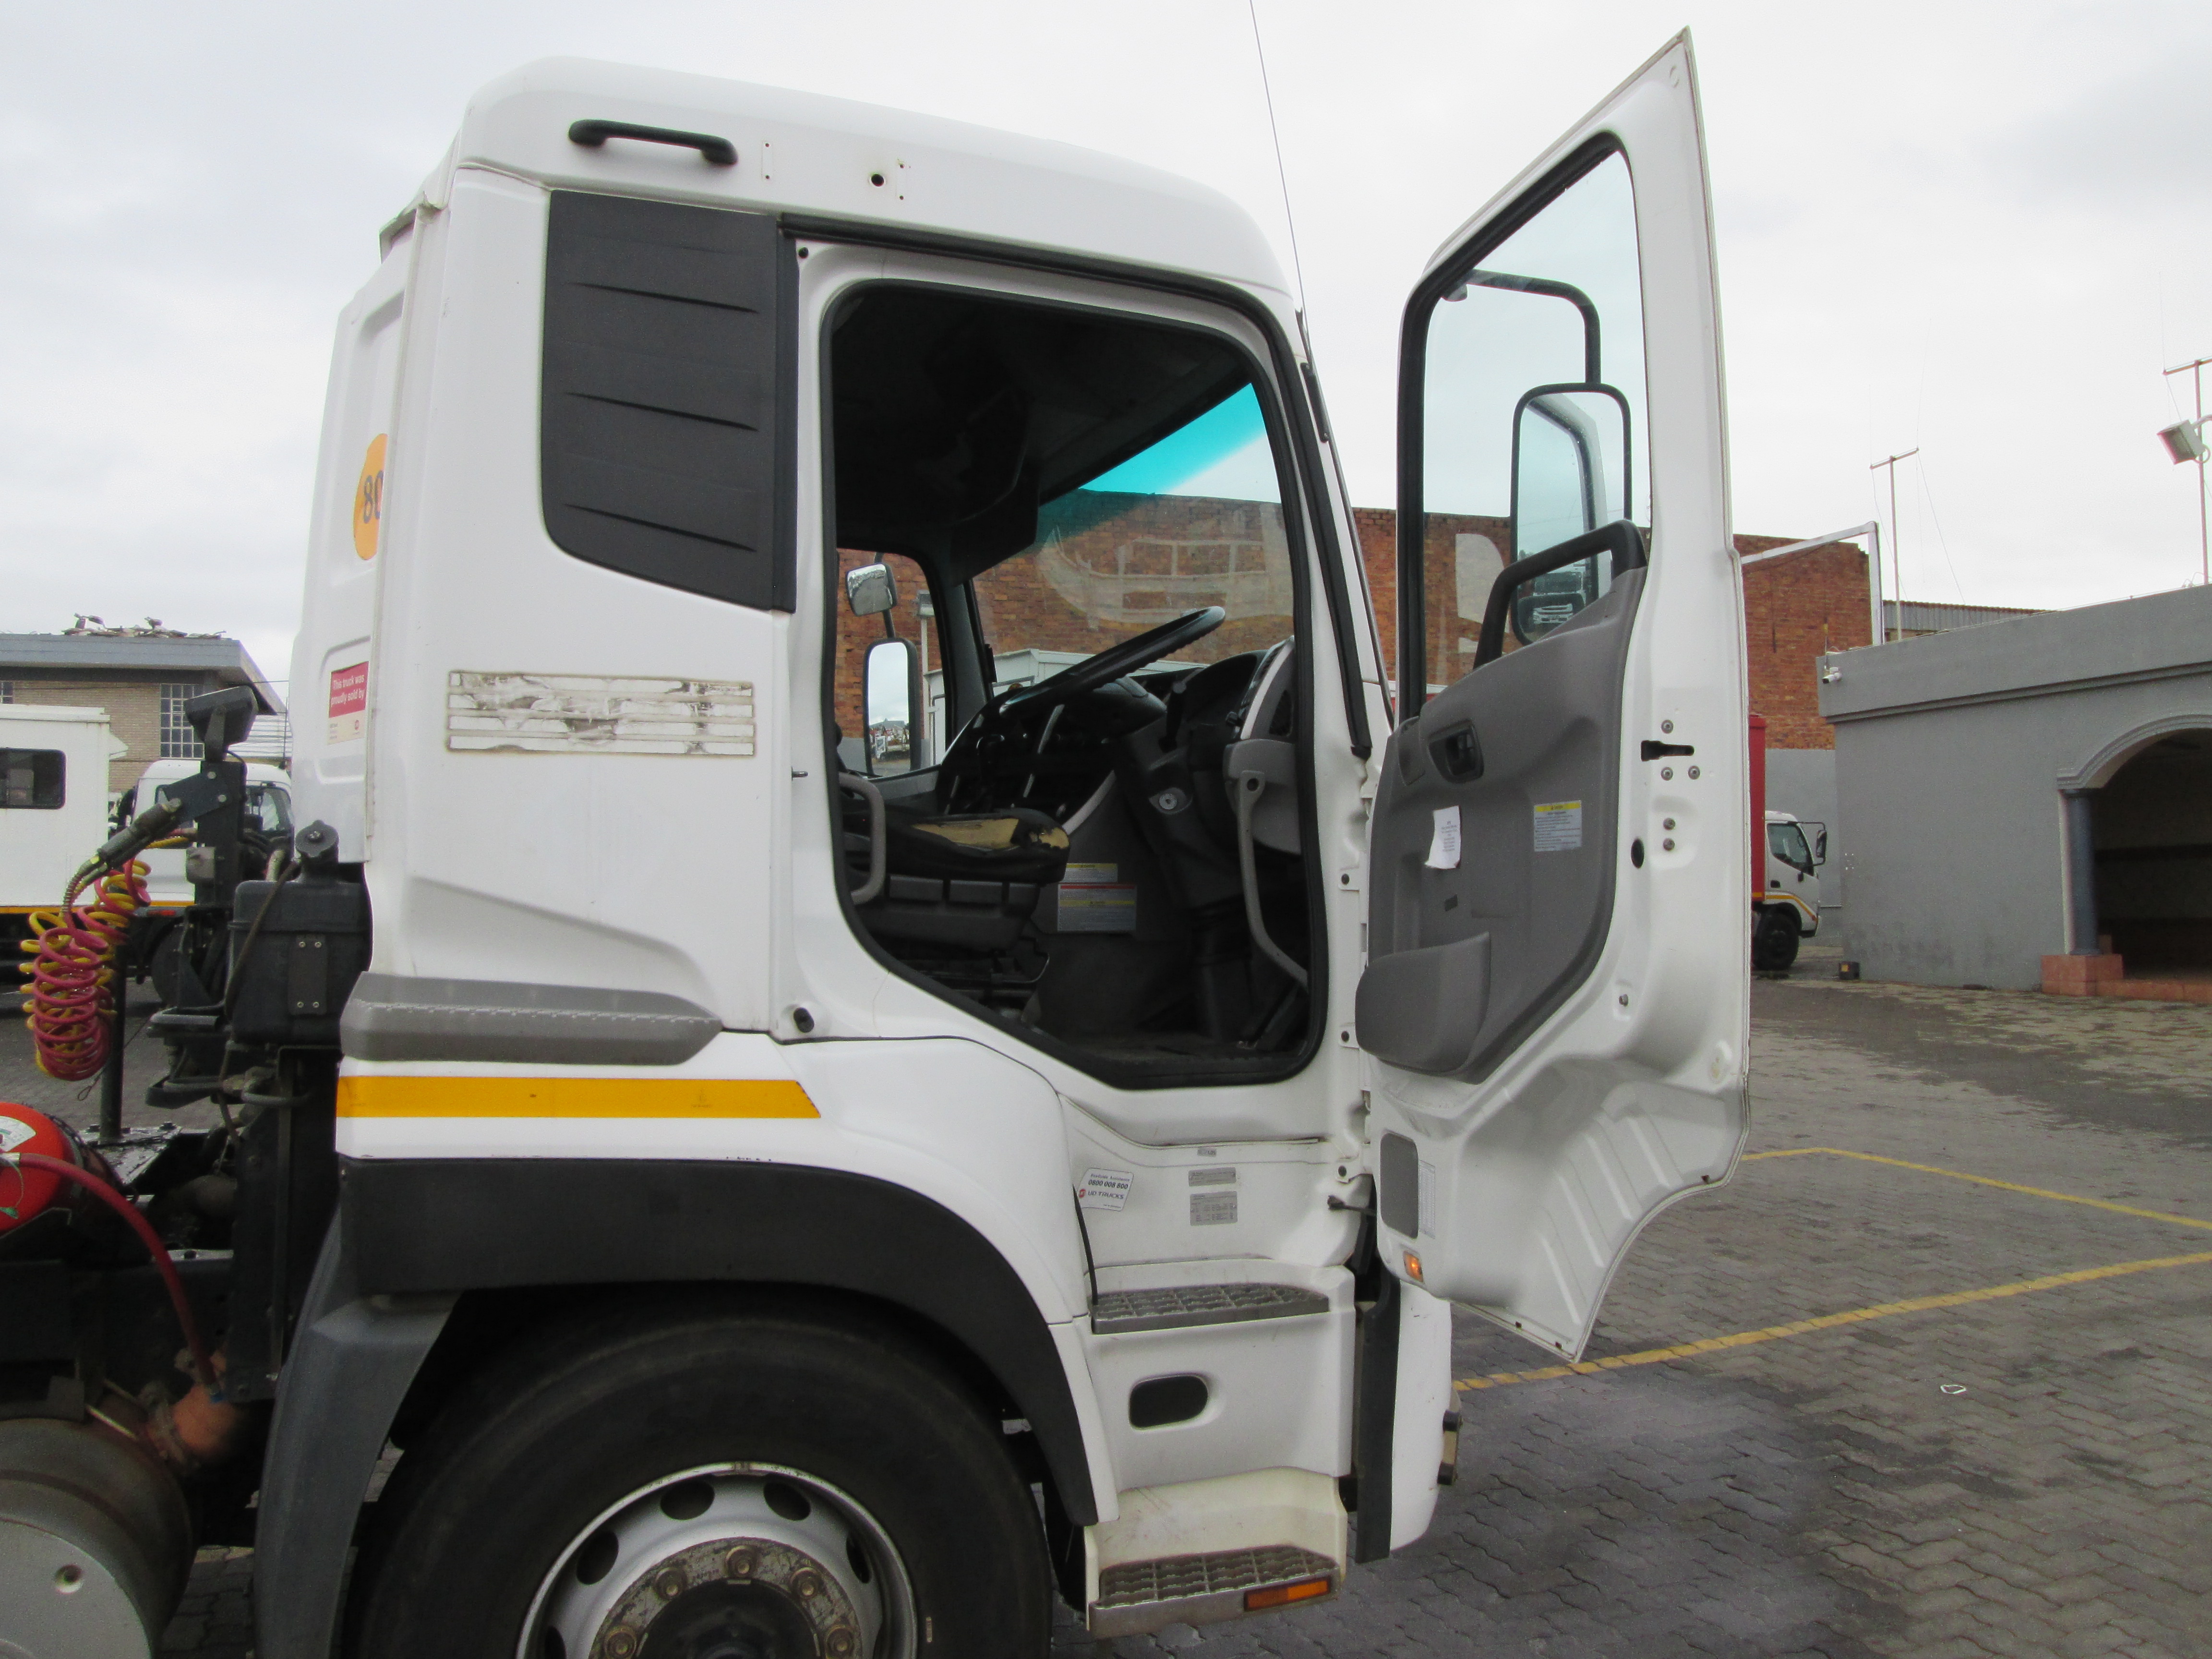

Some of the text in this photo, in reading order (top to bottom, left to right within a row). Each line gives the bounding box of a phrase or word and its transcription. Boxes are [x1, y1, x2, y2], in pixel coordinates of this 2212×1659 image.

[363, 469, 384, 524] 80
[333, 674, 364, 690] This truck was
[331, 688, 365, 707] proudly sold by
[1098, 1191, 1124, 1200] TRUCKS
